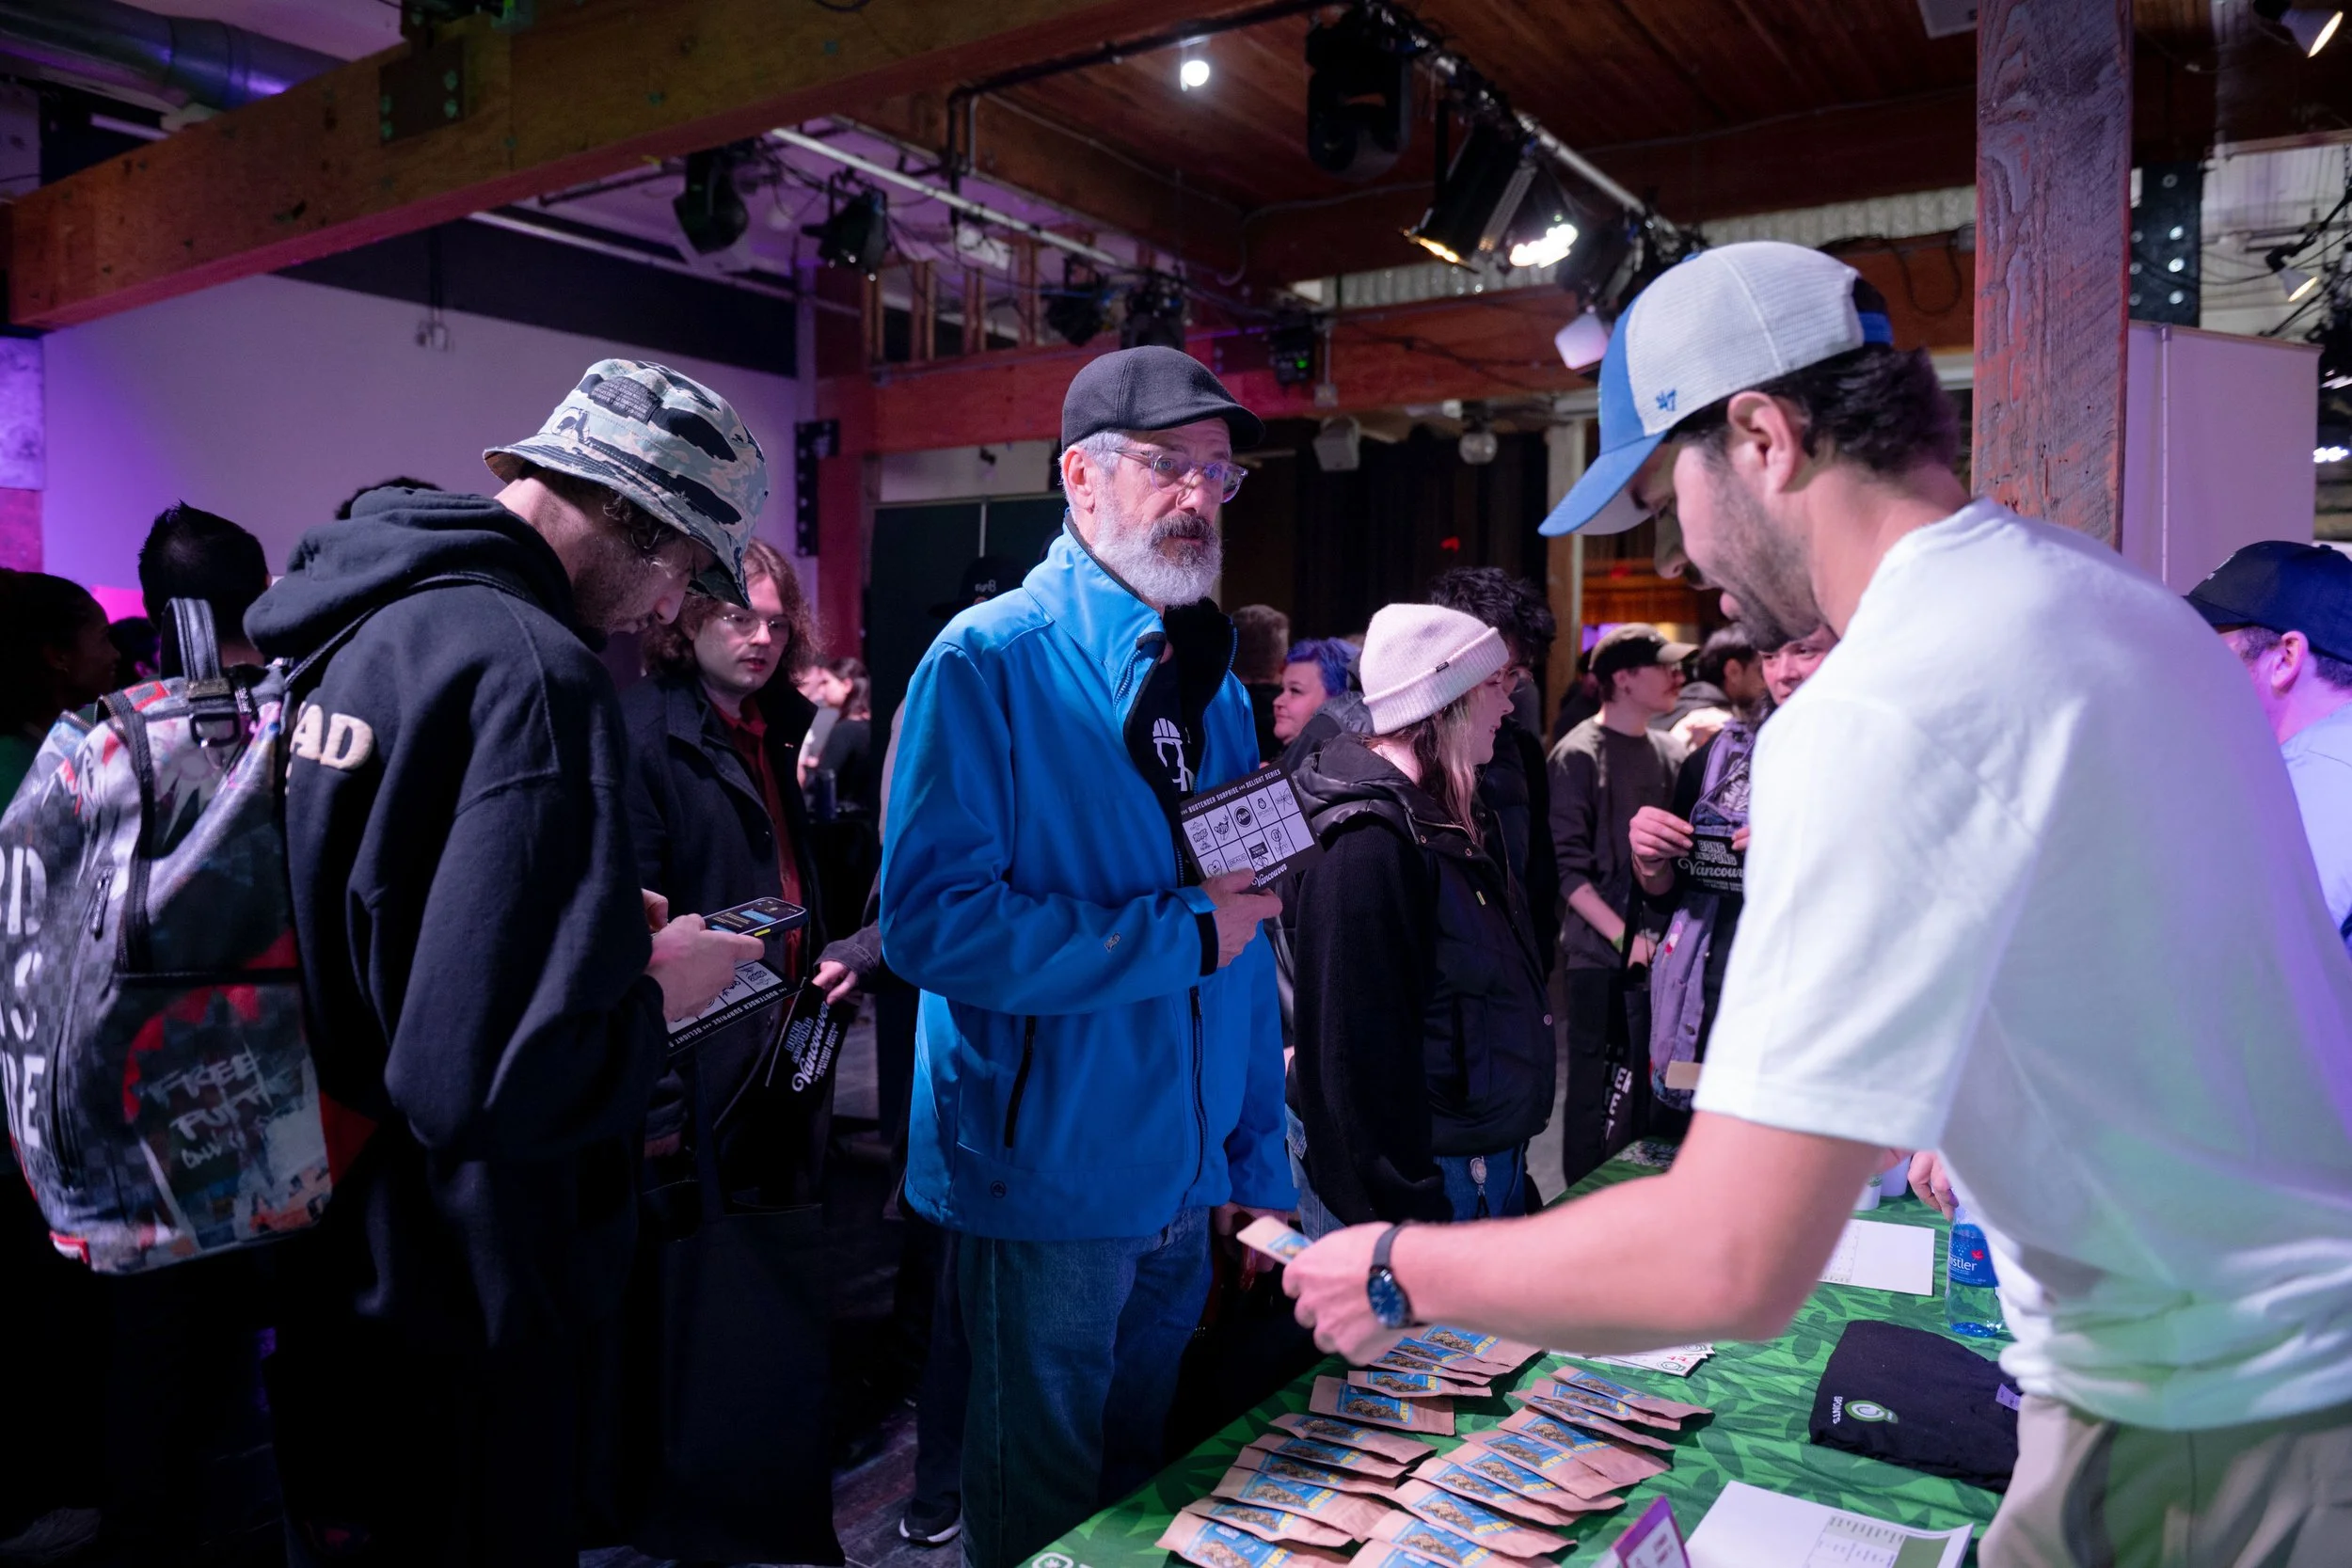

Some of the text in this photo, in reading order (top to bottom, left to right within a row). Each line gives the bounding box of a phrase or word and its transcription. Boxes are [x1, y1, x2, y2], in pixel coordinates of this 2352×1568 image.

[290, 701, 373, 769] AD
[1188, 795, 1216, 813] BUDTENDER
[1216, 787, 1239, 802] SURPRISE
[1246, 775, 1264, 788] DELIGHT
[1265, 768, 1281, 780] SERIES
[1251, 863, 1288, 887] Vancouver
[742, 989, 779, 1010] BUDTENDER
[711, 1006, 742, 1025] SURPRISE
[675, 1026, 702, 1044] DELIGHT
